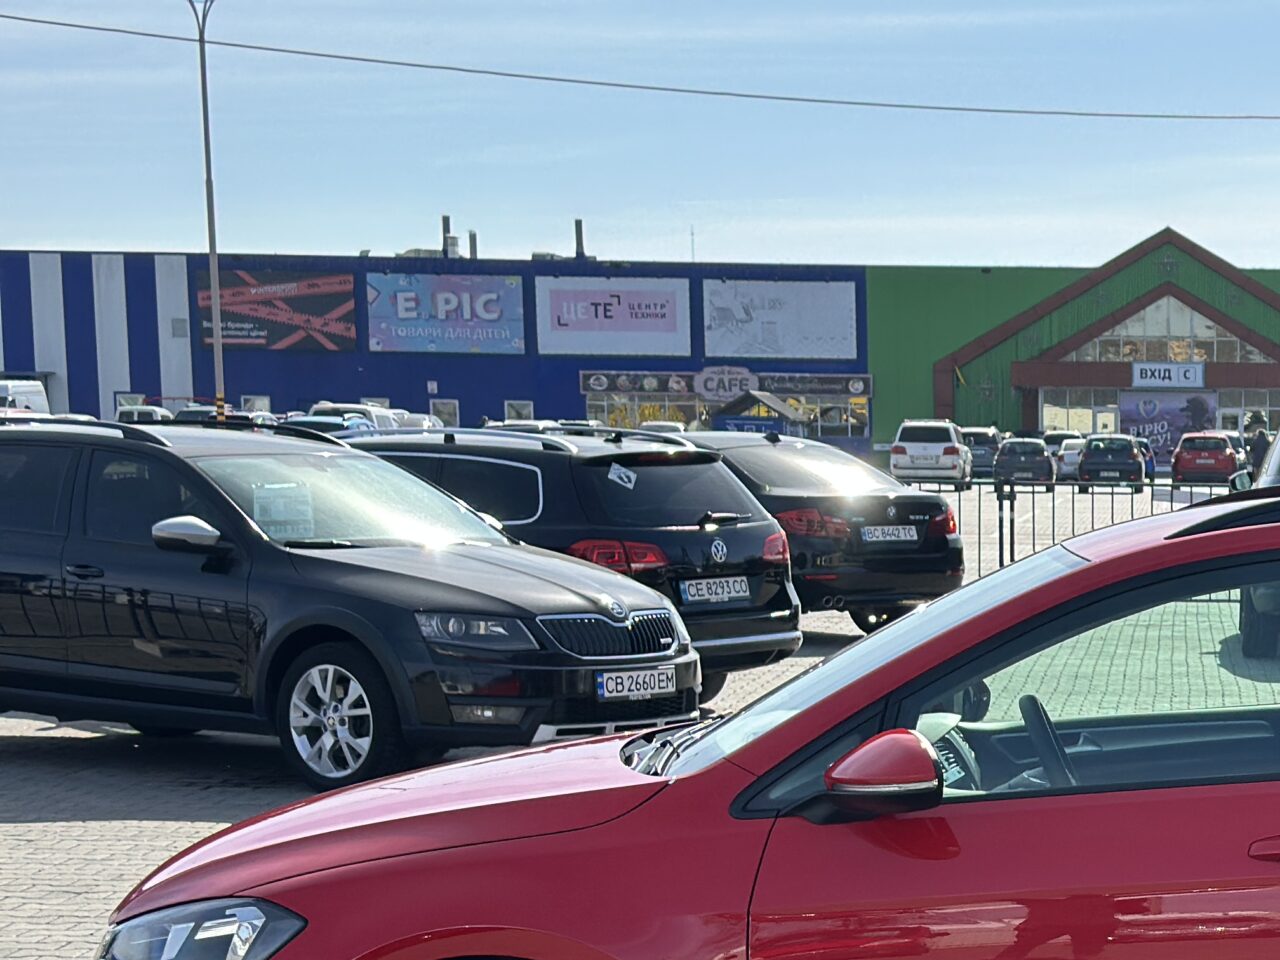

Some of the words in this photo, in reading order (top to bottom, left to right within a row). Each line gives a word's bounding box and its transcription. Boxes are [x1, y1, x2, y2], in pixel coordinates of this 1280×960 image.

[628, 303, 667, 311] ЦЕНТР
[390, 326, 441, 338] ТОВАРИ
[444, 327, 471, 340] ДЛЯ
[473, 325, 510, 341] ДІТЕЙ
[1139, 367, 1172, 382] ВХІД
[703, 376, 750, 393] CAFE
[1148, 431, 1171, 447] СУ!
[866, 527, 880, 539] BC
[902, 526, 914, 538] TC
[687, 583, 705, 598] CE
[707, 580, 731, 596] 8293
[732, 579, 748, 594] CO
[605, 676, 625, 694] CB
[627, 674, 656, 692] 2660
[657, 672, 675, 690] EM
